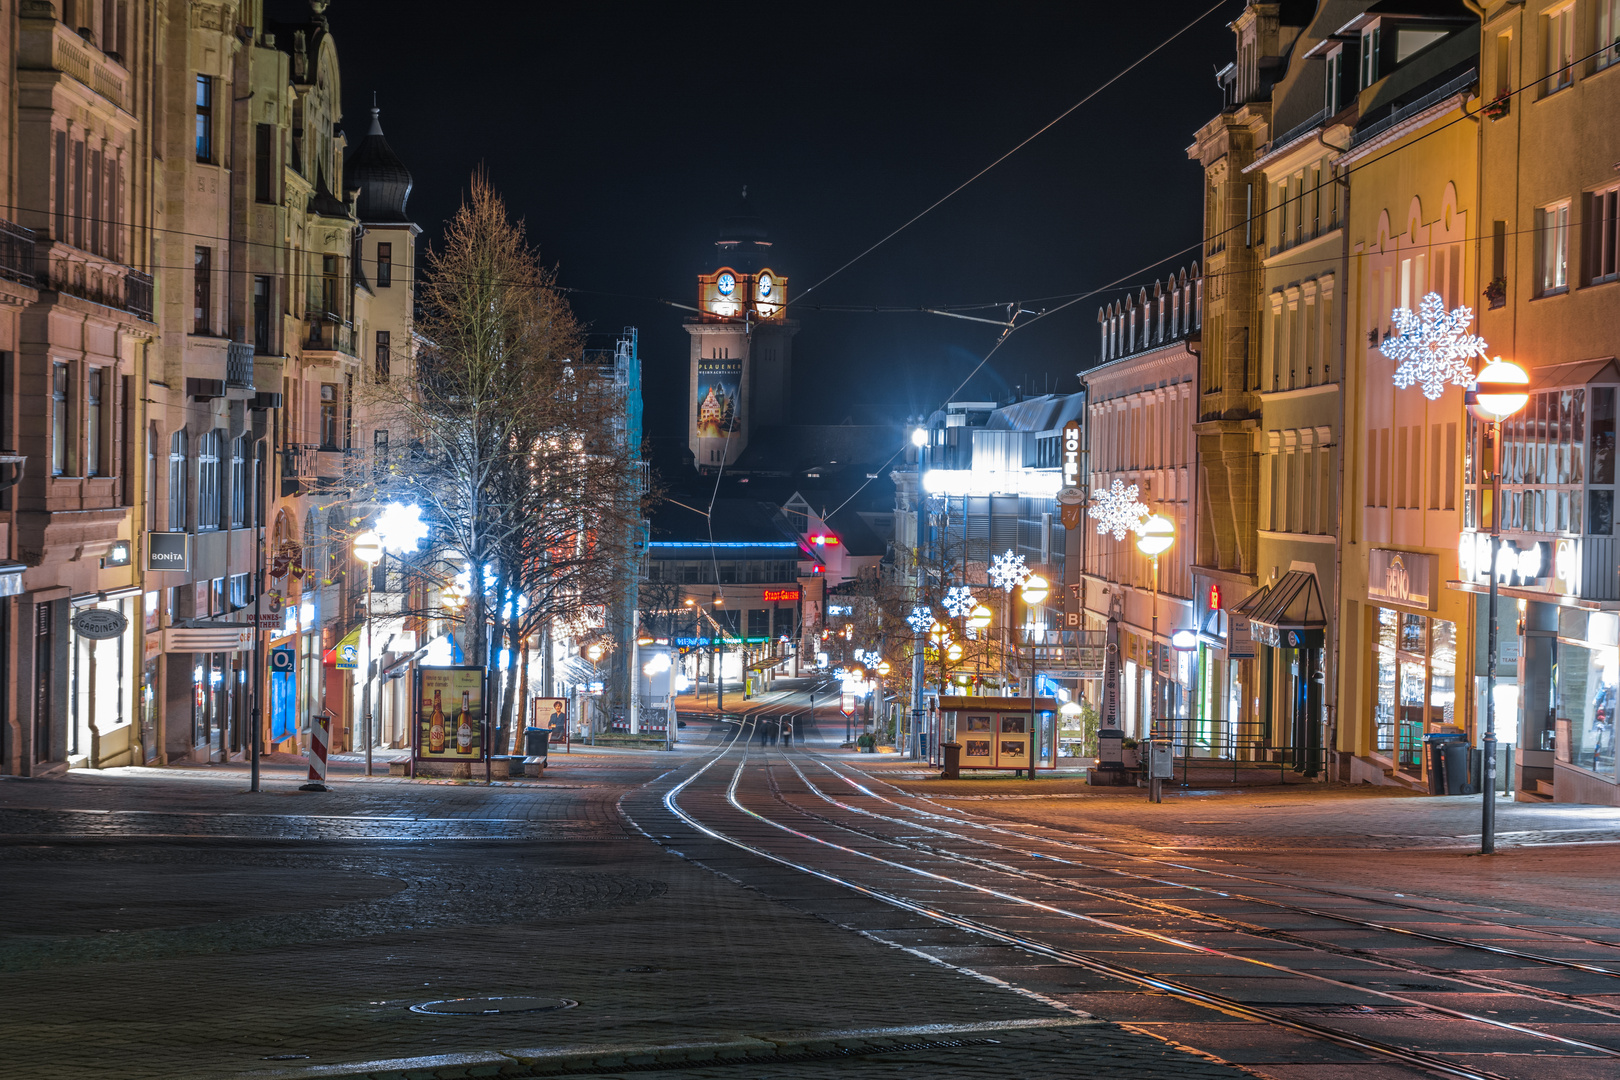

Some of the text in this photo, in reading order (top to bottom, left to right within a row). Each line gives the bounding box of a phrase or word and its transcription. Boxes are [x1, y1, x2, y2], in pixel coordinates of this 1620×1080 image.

[1064, 428, 1079, 486] HOTEL
[1386, 567, 1409, 600] RENO
[80, 620, 119, 633] GARDINEN
[1107, 661, 1116, 725] Wettiner Stuben
